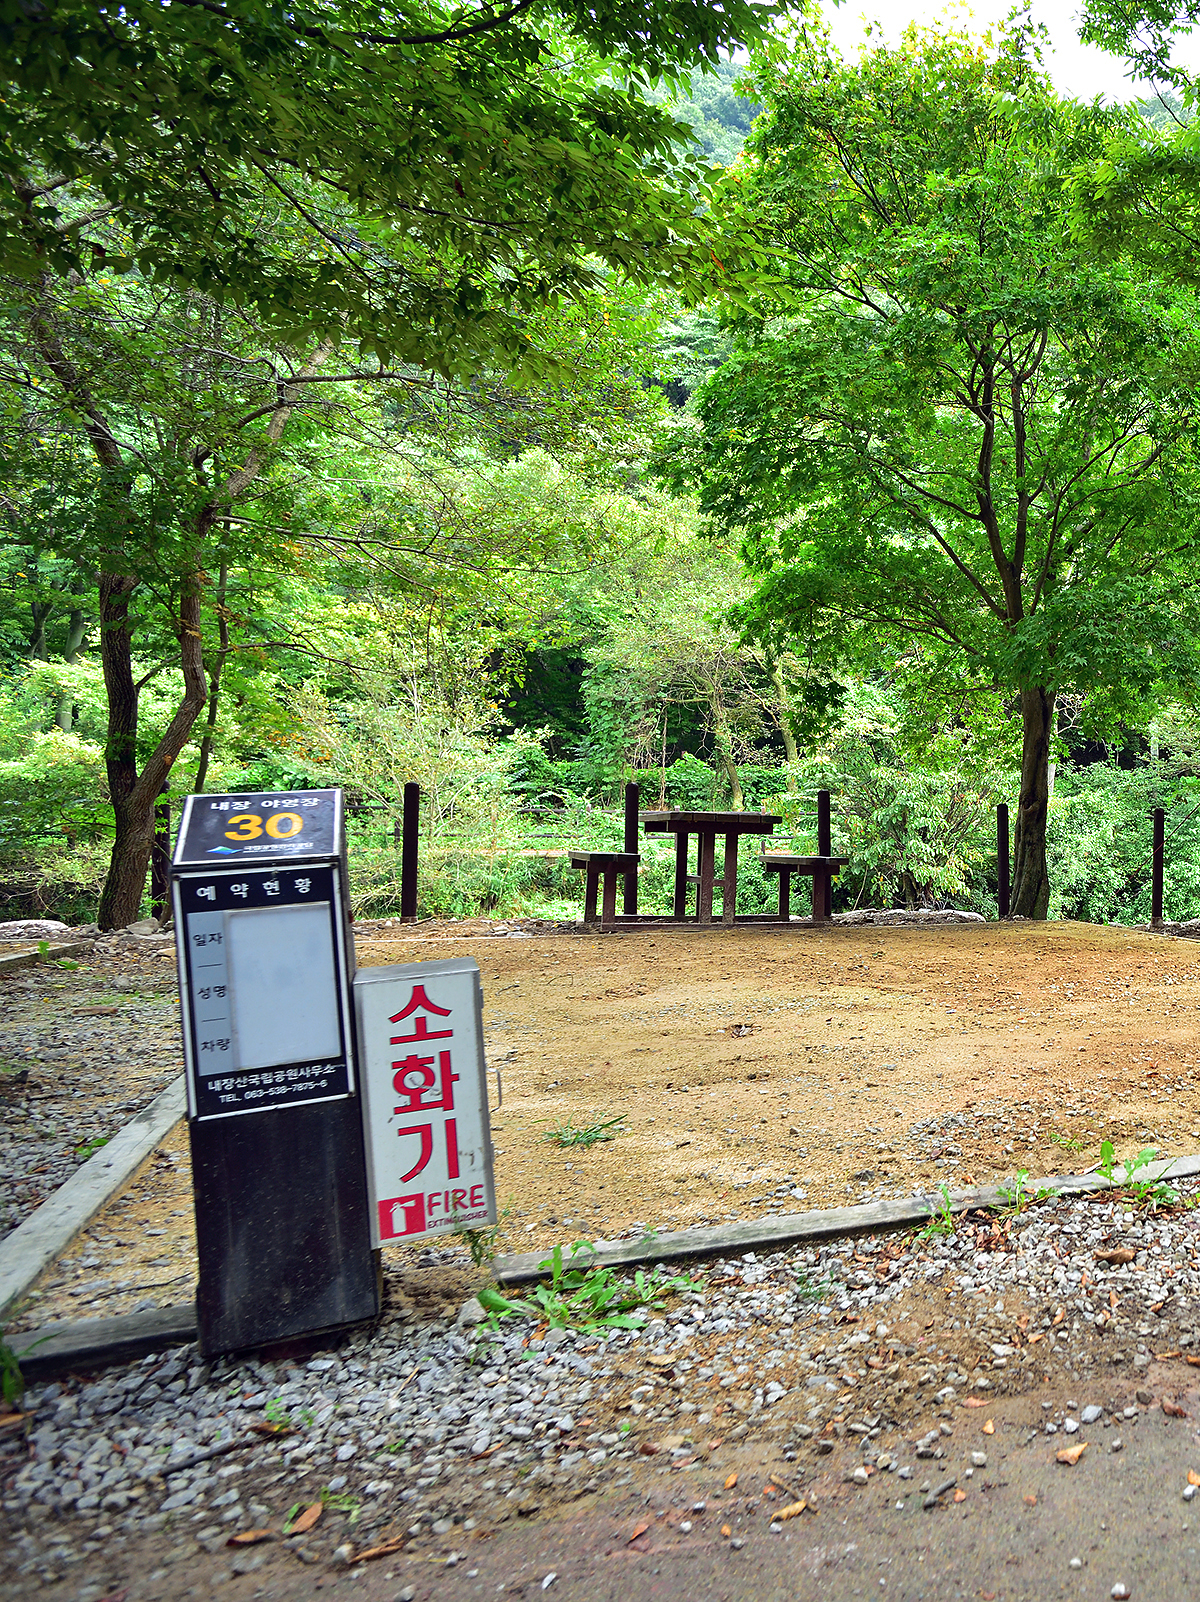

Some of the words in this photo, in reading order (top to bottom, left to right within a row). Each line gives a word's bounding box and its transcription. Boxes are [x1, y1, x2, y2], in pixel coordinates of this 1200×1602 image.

[210, 801, 252, 811] 내장
[260, 797, 321, 809] 야영장
[224, 812, 304, 841] 30
[192, 932, 223, 947] 일자
[197, 985, 227, 1000] 성명
[201, 1038, 231, 1053] 차량
[207, 1063, 337, 1092] 내장산국립공원사무소
[387, 984, 460, 1184] 소화기
[427, 1184, 485, 1216] FIRE
